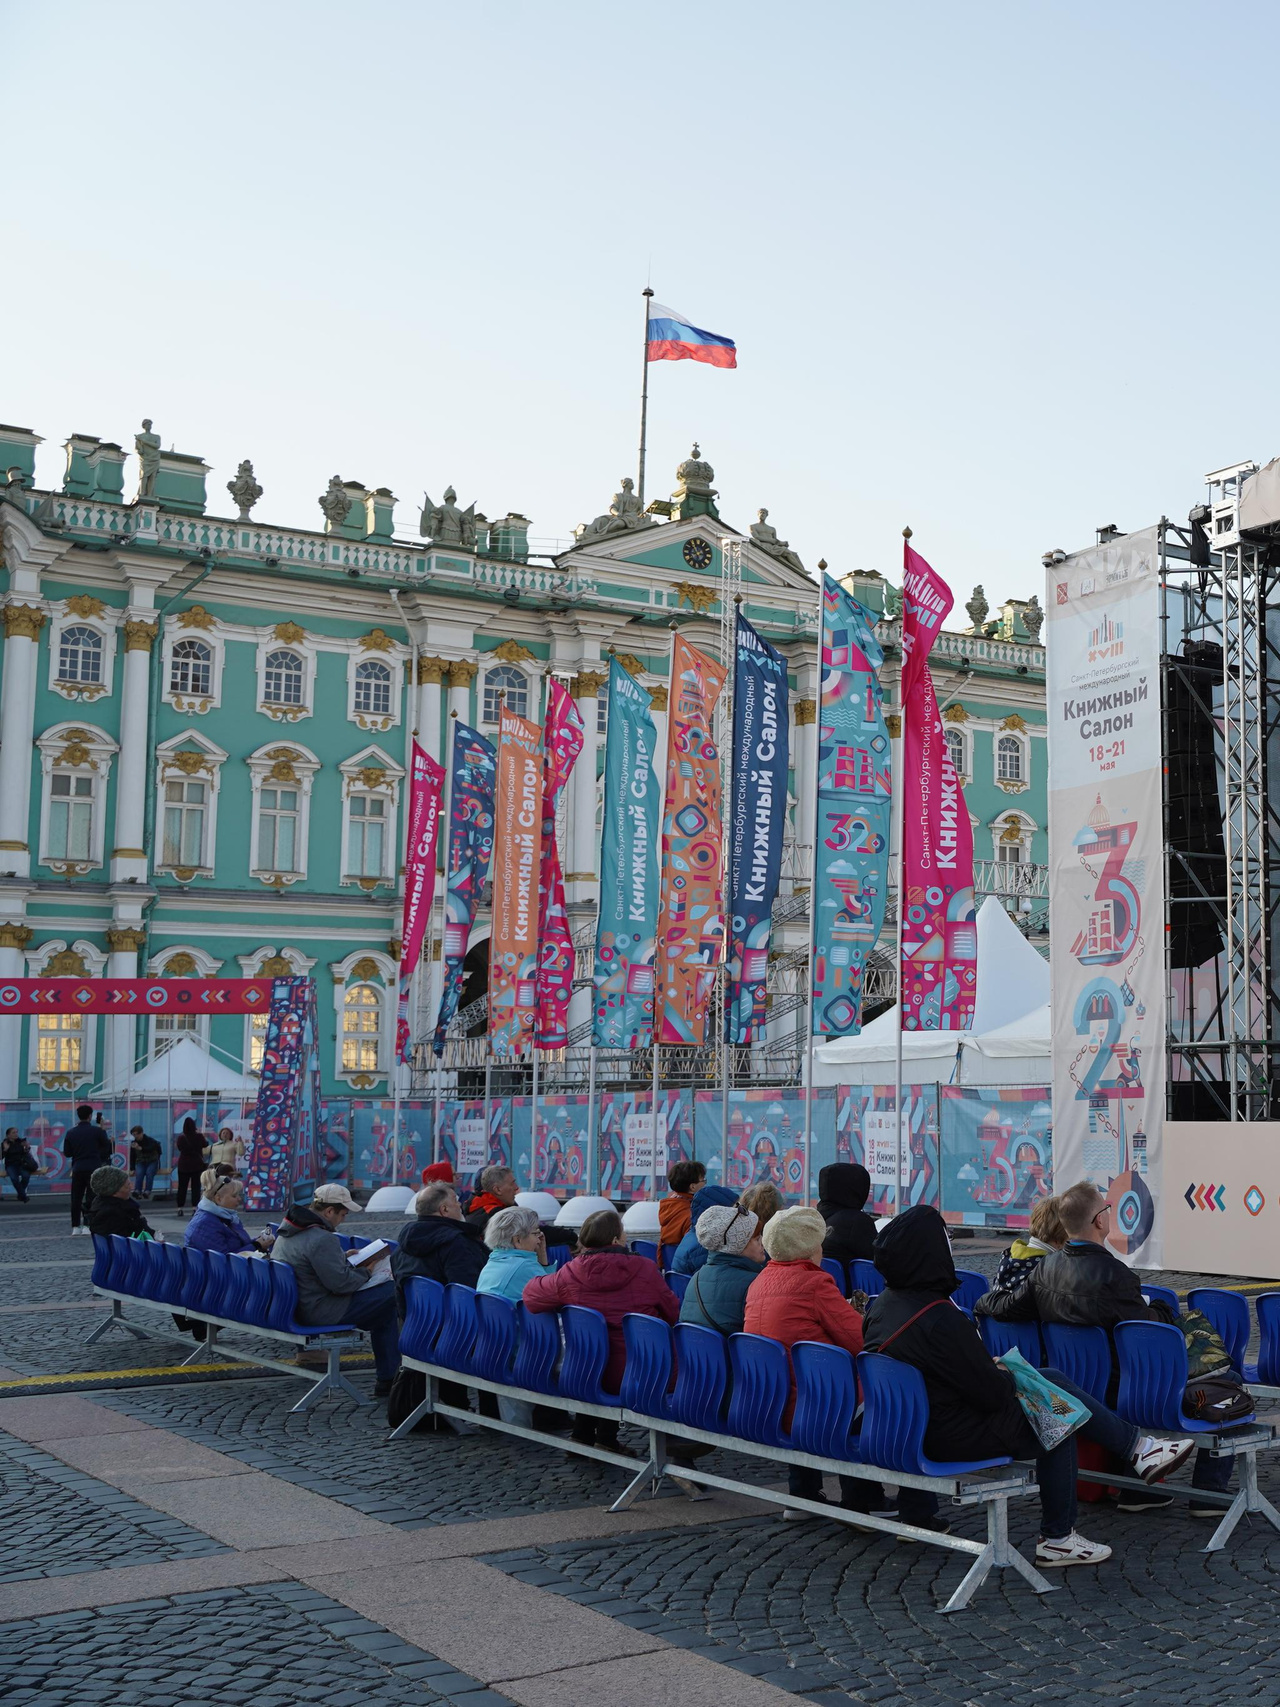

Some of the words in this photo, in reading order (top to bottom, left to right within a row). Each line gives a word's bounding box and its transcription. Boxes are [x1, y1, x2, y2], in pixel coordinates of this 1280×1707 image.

[923, 660, 933, 722] междуна
[1063, 677, 1148, 721] Книжный
[1071, 657, 1140, 684] Санкт-Петербургский
[1079, 671, 1131, 692] международный
[742, 675, 755, 769] международный
[756, 680, 777, 762] Салон
[1079, 712, 1134, 740] Салон
[619, 719, 630, 804] международный
[1100, 759, 1116, 772] мая
[506, 756, 516, 834] международный
[518, 759, 537, 828] Салон
[920, 726, 933, 870] Санкт-Петербургский
[615, 806, 626, 921] Санкт-Петербургский
[628, 804, 647, 922] Книжный
[744, 770, 774, 902] Книжный
[401, 863, 426, 960] Книжный
[417, 795, 438, 858] Салон
[500, 836, 513, 941] Санкт-Петербургский
[514, 834, 535, 941] Книжный
[629, 1138, 635, 1147] 18
[629, 1151, 635, 1160] 21
[636, 1146, 664, 1157] Книжый
[636, 1158, 651, 1167] Салон
[869, 1139, 875, 1150] 18
[869, 1154, 875, 1165] 21
[876, 1163, 896, 1175] Салон
